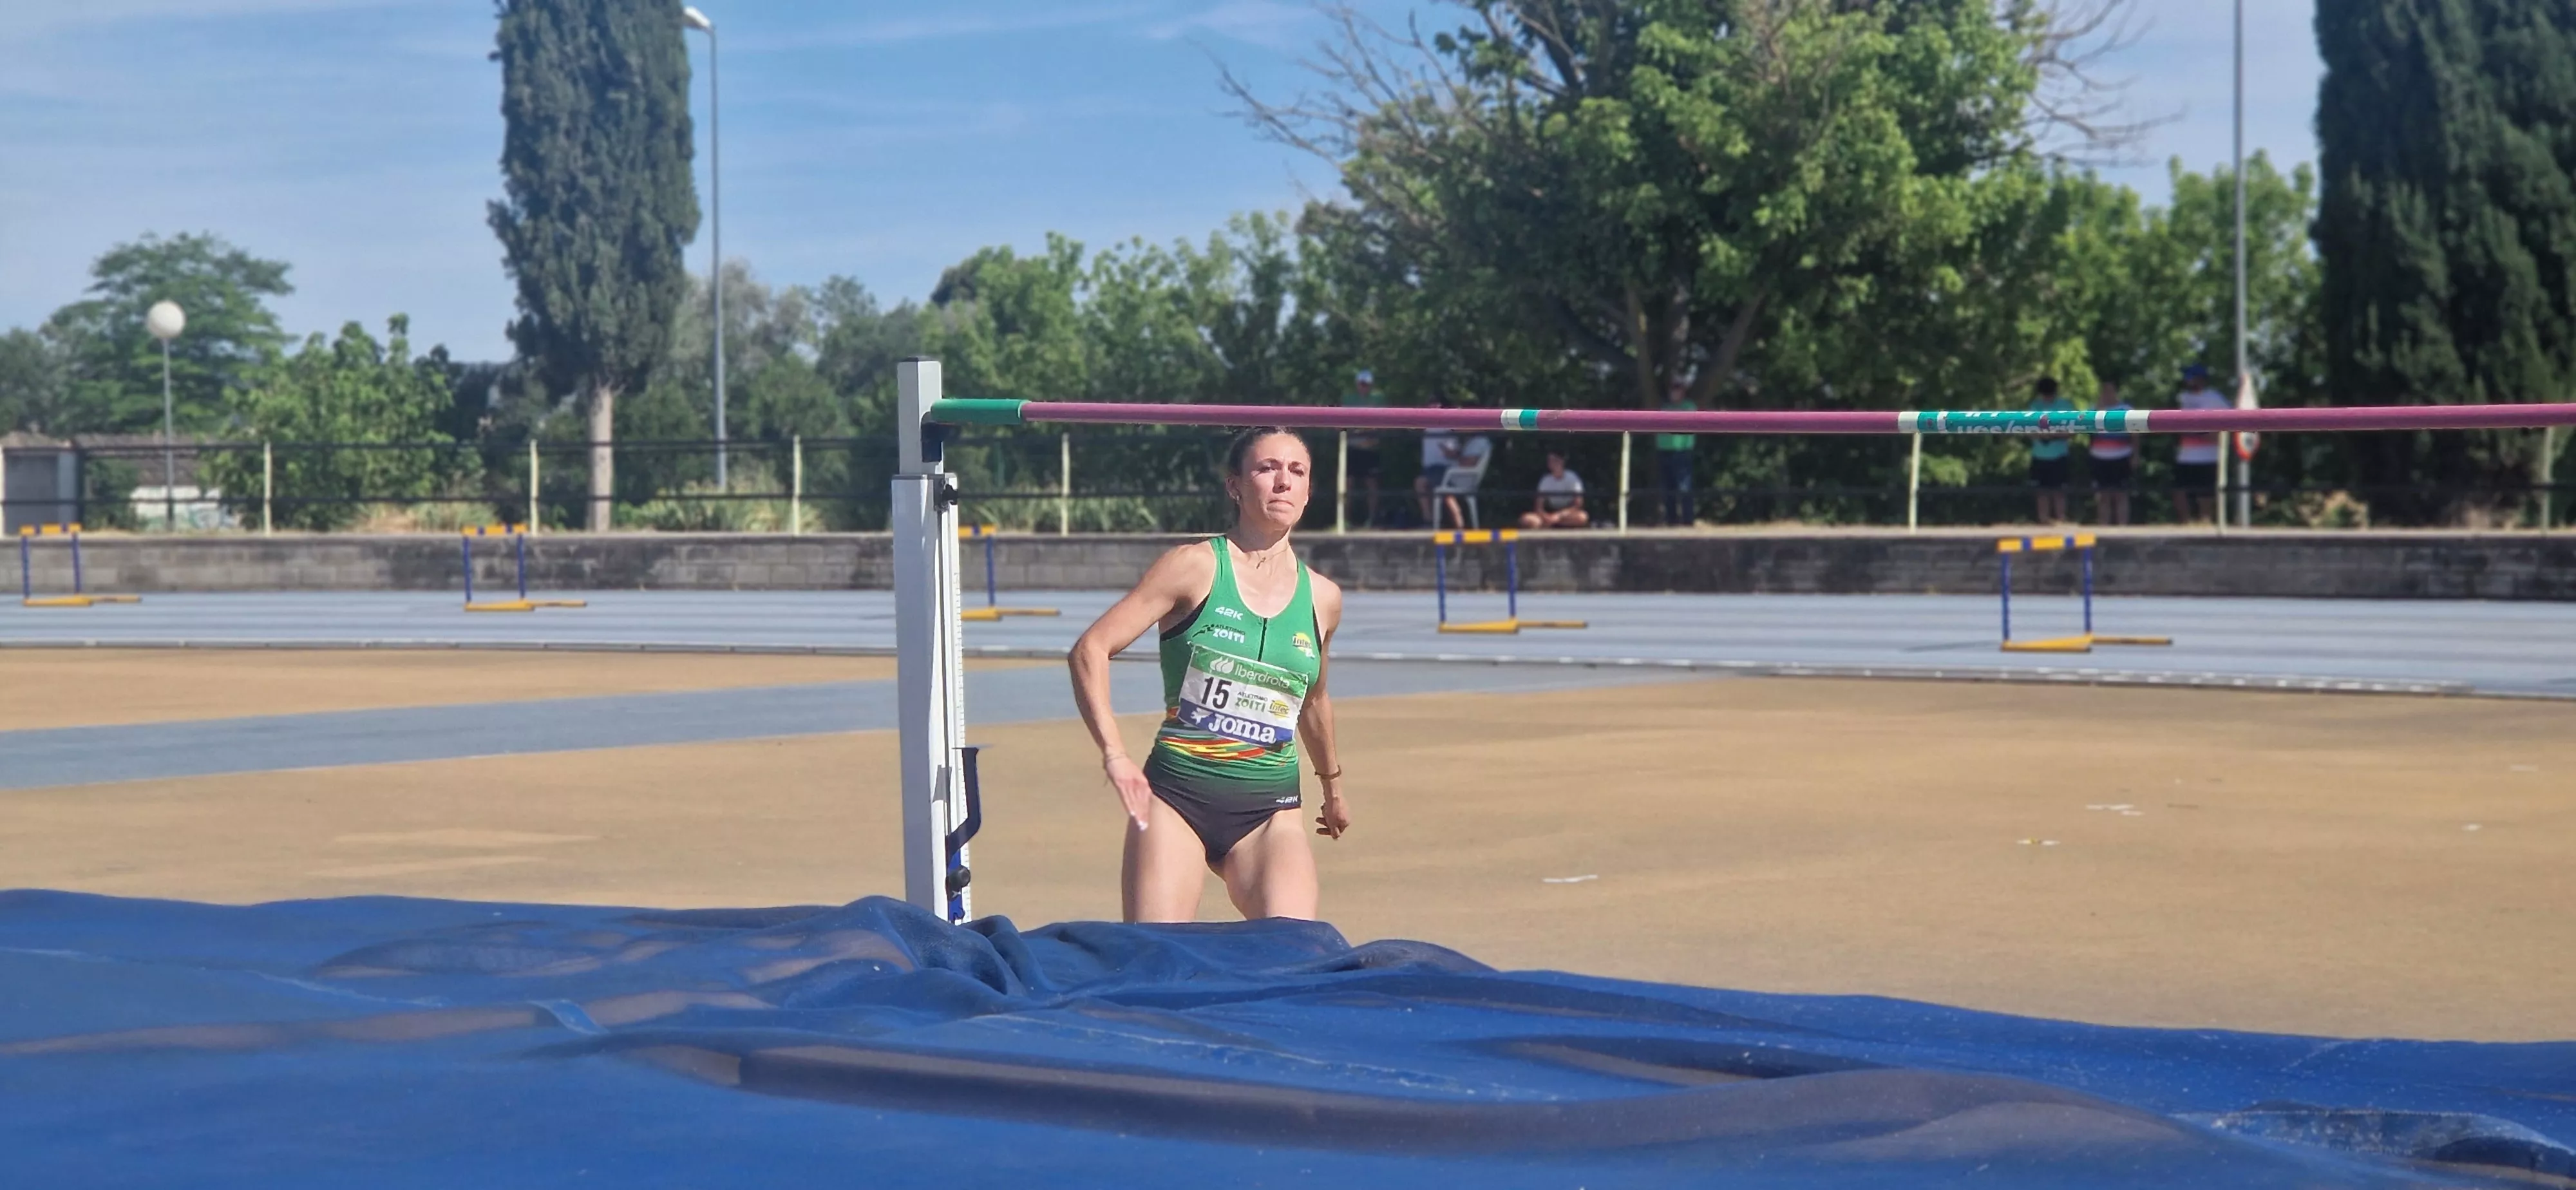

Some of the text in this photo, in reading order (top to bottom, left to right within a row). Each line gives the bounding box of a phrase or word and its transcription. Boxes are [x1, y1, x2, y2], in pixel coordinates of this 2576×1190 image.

[1215, 607, 1244, 620] 42K
[1213, 628, 1245, 643] ZOITI
[1235, 664, 1291, 688] Iberdrola
[1201, 677, 1232, 709] 15
[1235, 697, 1265, 712] ZOITI
[1208, 713, 1276, 744] Joma
